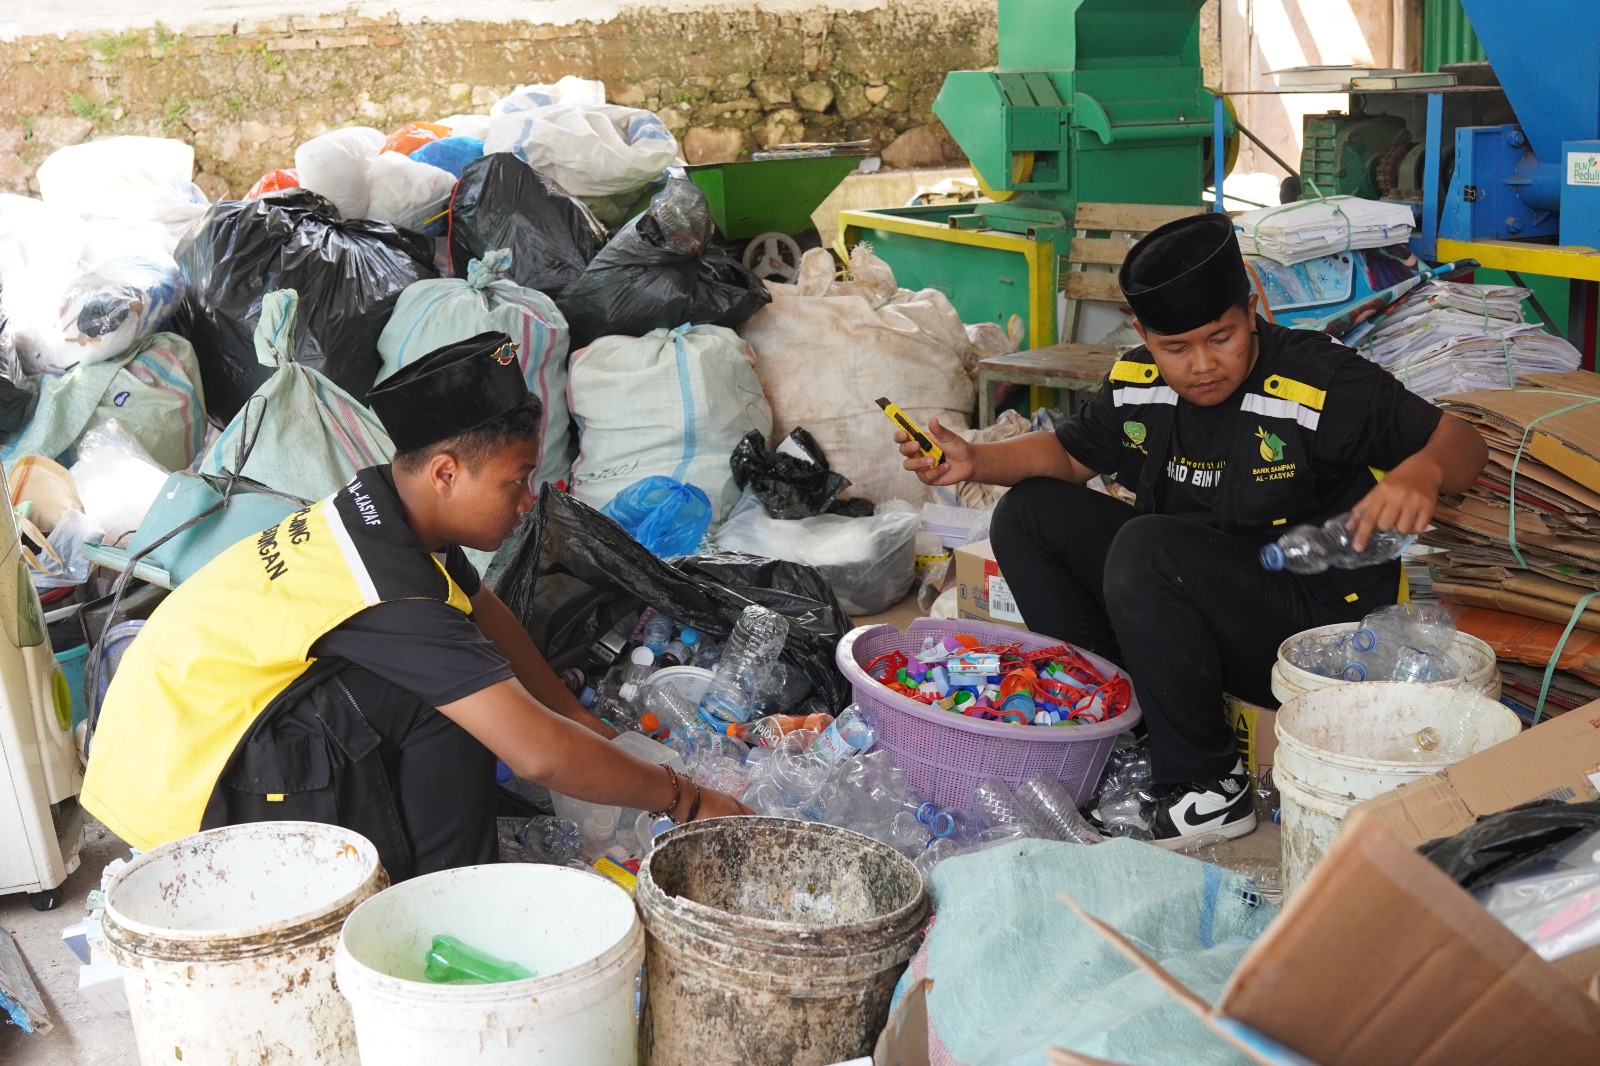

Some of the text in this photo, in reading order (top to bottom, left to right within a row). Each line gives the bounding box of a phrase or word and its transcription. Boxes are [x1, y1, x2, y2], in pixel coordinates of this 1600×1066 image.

[1574, 162, 1587, 170] PLN
[1574, 170, 1600, 181] Peduli
[1252, 462, 1296, 475] BANK SAMPAH
[1191, 469, 1213, 488] BIN
